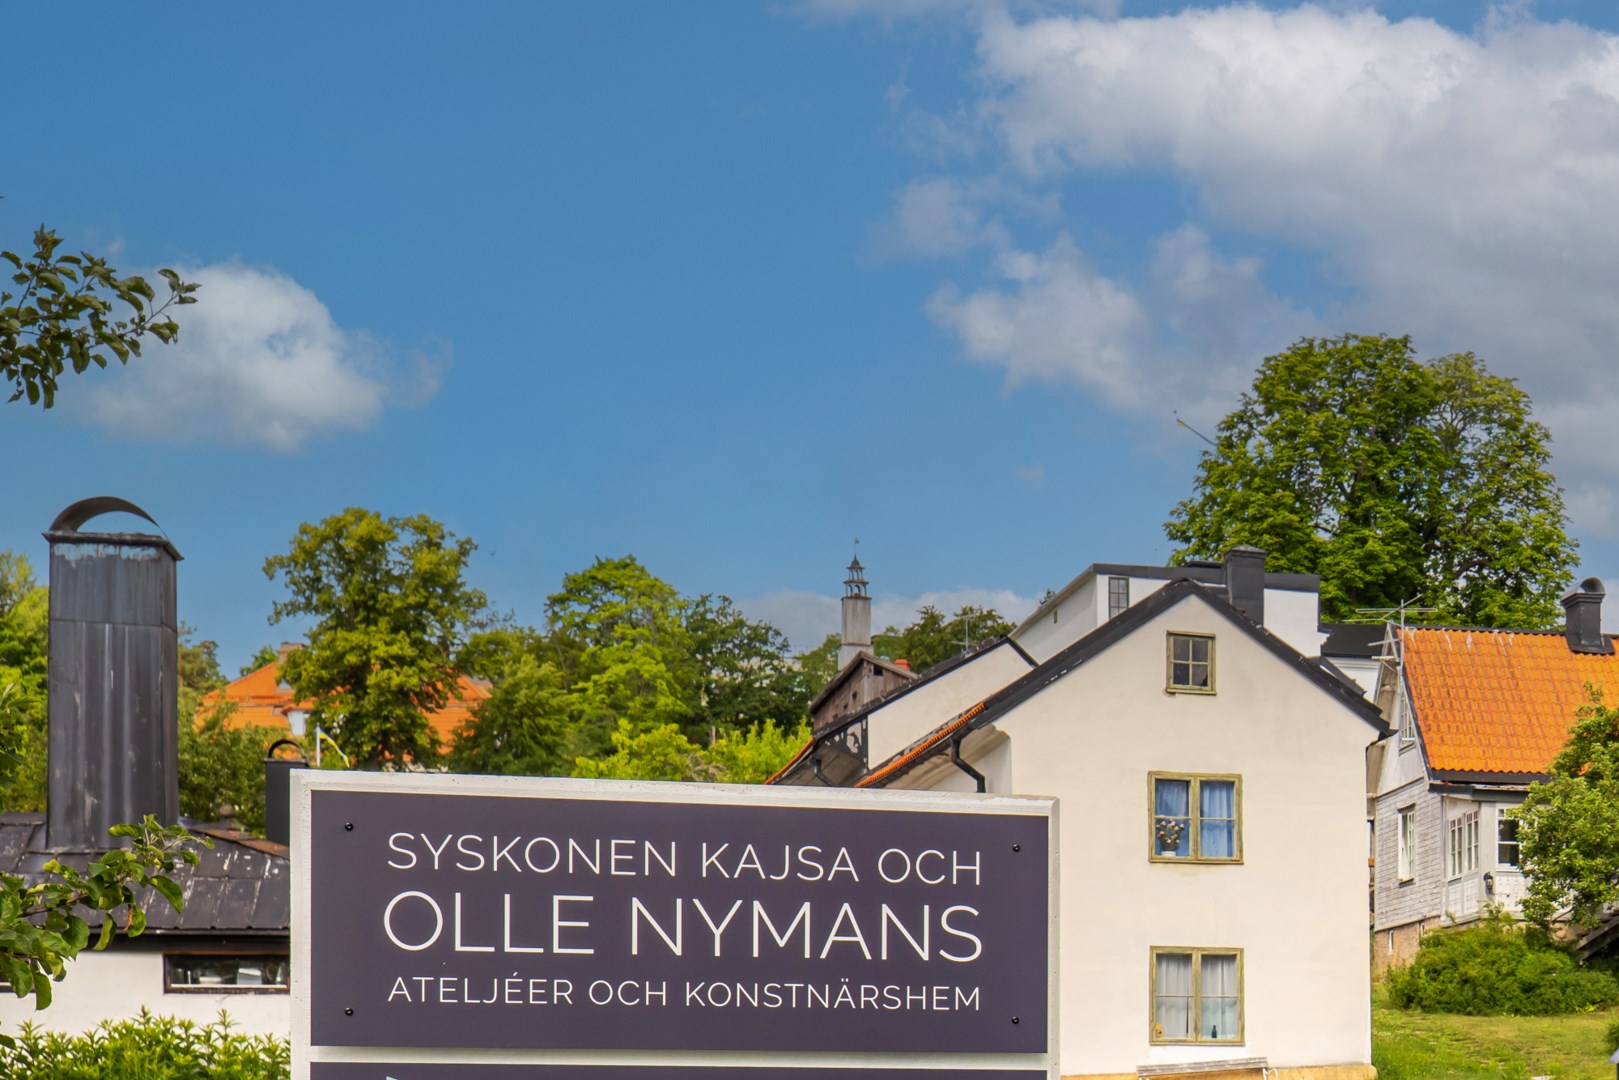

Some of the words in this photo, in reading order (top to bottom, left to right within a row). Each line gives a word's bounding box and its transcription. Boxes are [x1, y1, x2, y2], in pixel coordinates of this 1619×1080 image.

[387, 832, 676, 877] SYSKONEN
[702, 842, 860, 882] KAJSA
[877, 848, 981, 886] OCH
[383, 890, 595, 955] OLLE
[631, 896, 982, 963] NYMANS
[387, 971, 573, 1005] ATELJÉER
[588, 979, 667, 1006] OCH
[685, 977, 980, 1011] KONSTNÄRSHEM
